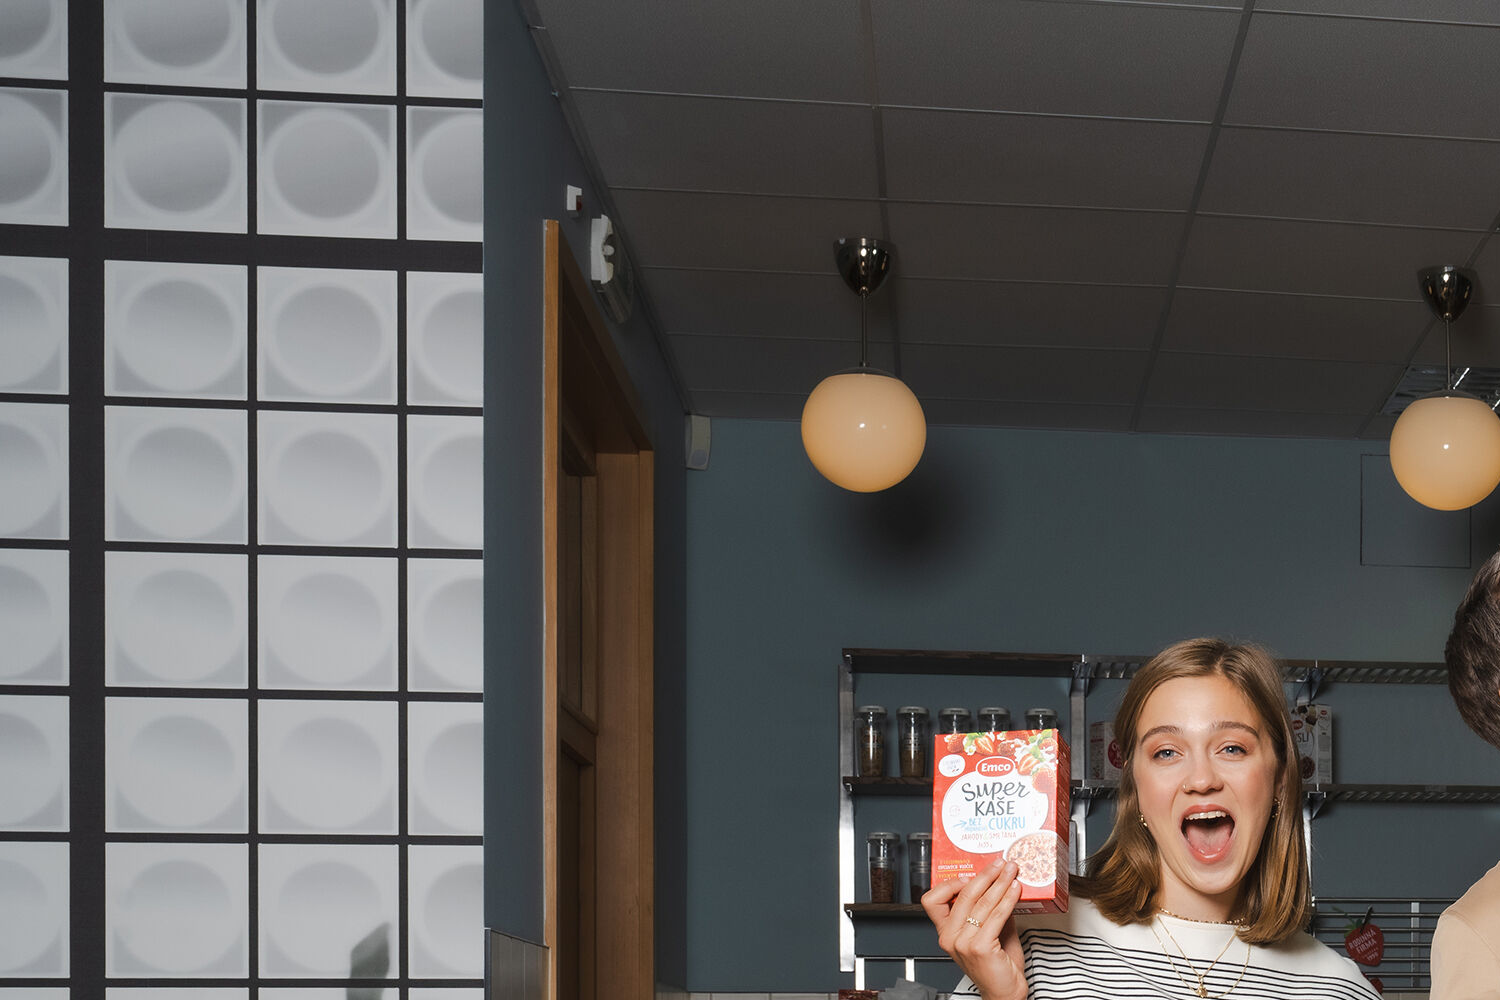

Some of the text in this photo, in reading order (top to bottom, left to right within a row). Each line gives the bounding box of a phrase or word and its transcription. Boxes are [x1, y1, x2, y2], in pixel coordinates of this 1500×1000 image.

[981, 763, 1011, 773] Emco
[961, 781, 1030, 801] Super
[974, 797, 1015, 816] KAŠE
[968, 816, 1025, 831] BEZ CUKRU
[1356, 938, 1377, 953] FIRMA
